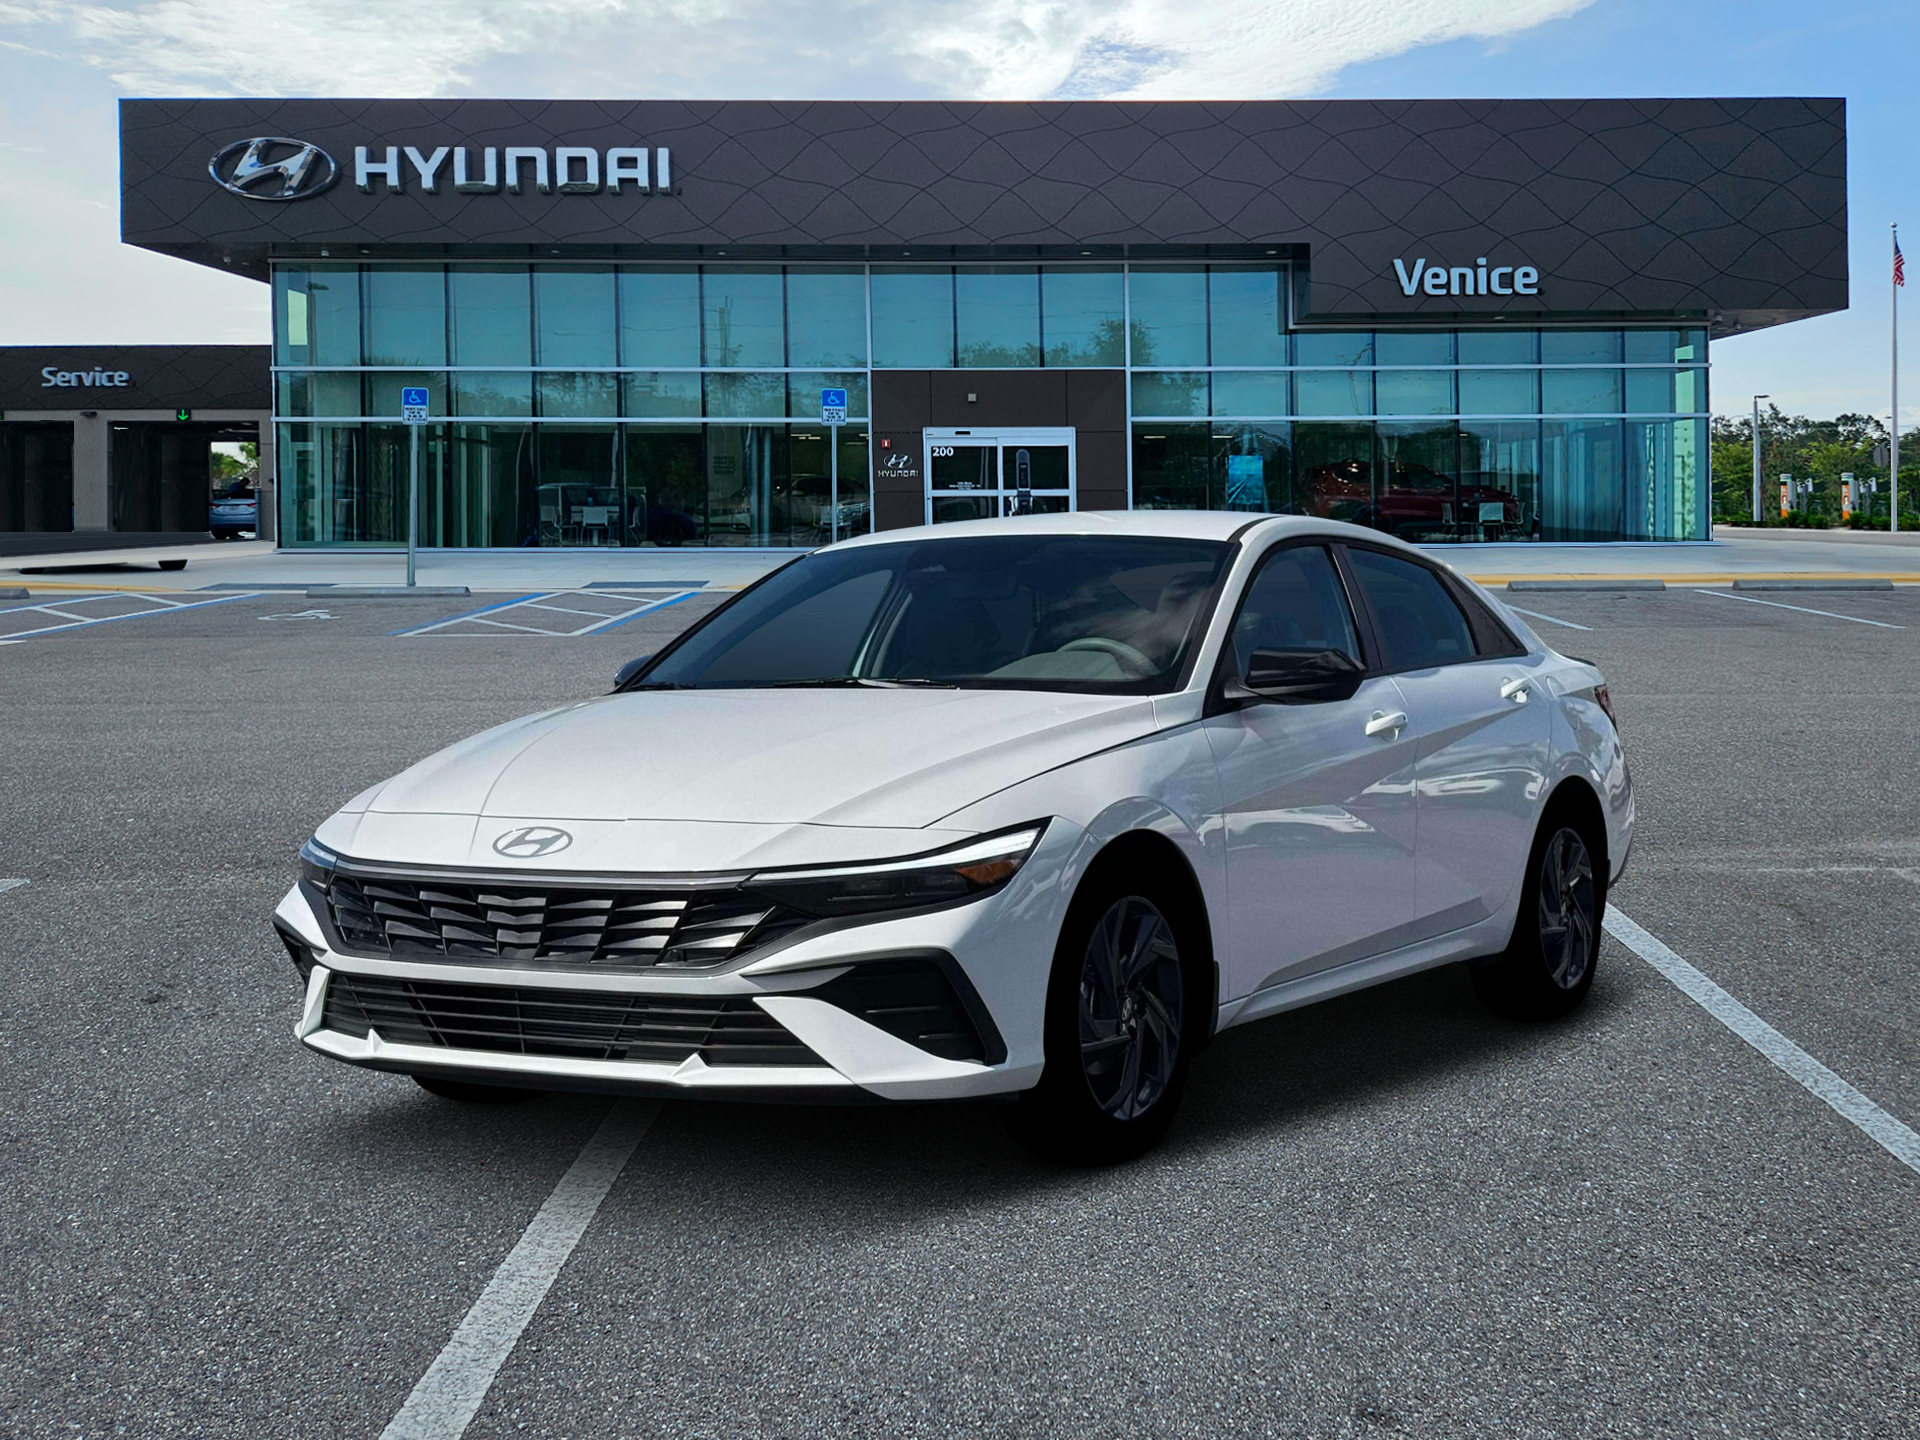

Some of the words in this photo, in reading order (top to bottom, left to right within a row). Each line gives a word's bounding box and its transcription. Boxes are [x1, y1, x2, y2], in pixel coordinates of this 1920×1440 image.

[355, 146, 671, 194] HYUNDAI
[1392, 257, 1539, 296] Venice
[41, 366, 130, 387] Service
[932, 447, 954, 457] 200
[877, 469, 919, 478] HYUNDAI
